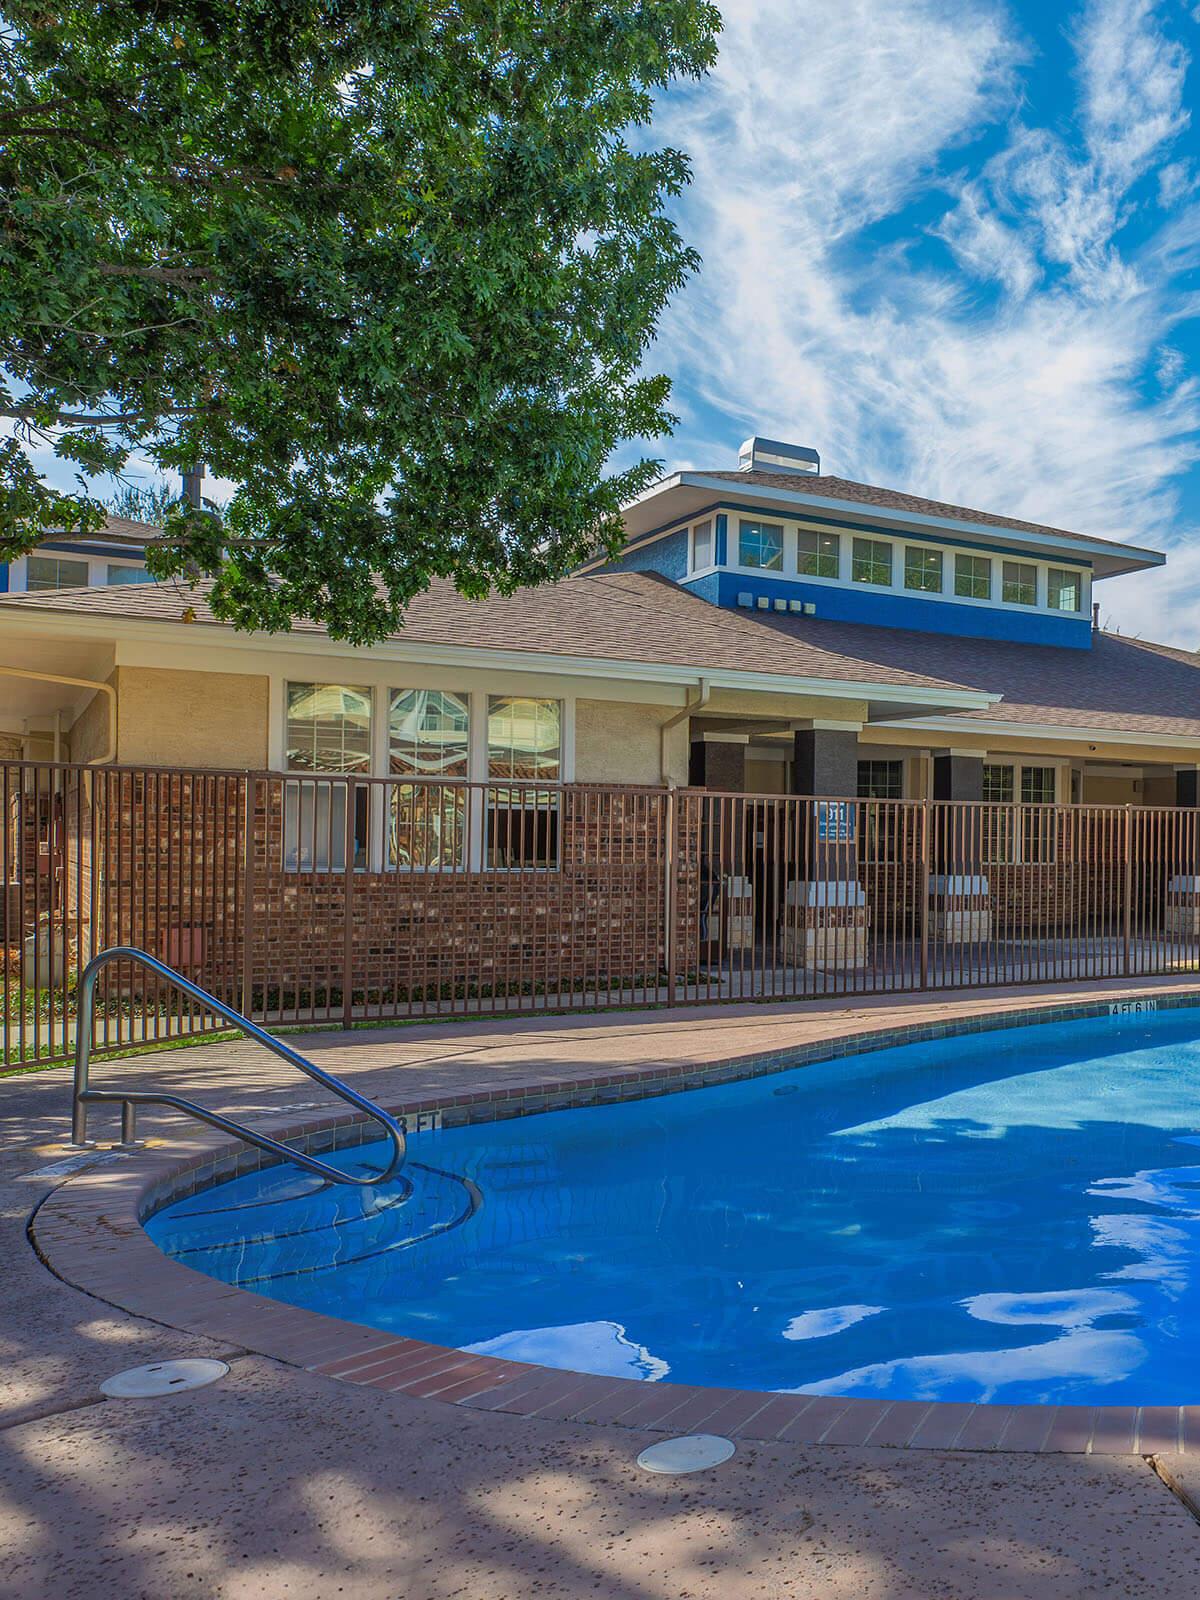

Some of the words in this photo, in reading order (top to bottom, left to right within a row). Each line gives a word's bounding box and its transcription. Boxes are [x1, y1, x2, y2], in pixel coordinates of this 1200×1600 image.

[1112, 1003, 1119, 1015] 4
[1121, 1003, 1131, 1014] FT
[1135, 1002, 1142, 1013] 6
[416, 1110, 440, 1133] FT
